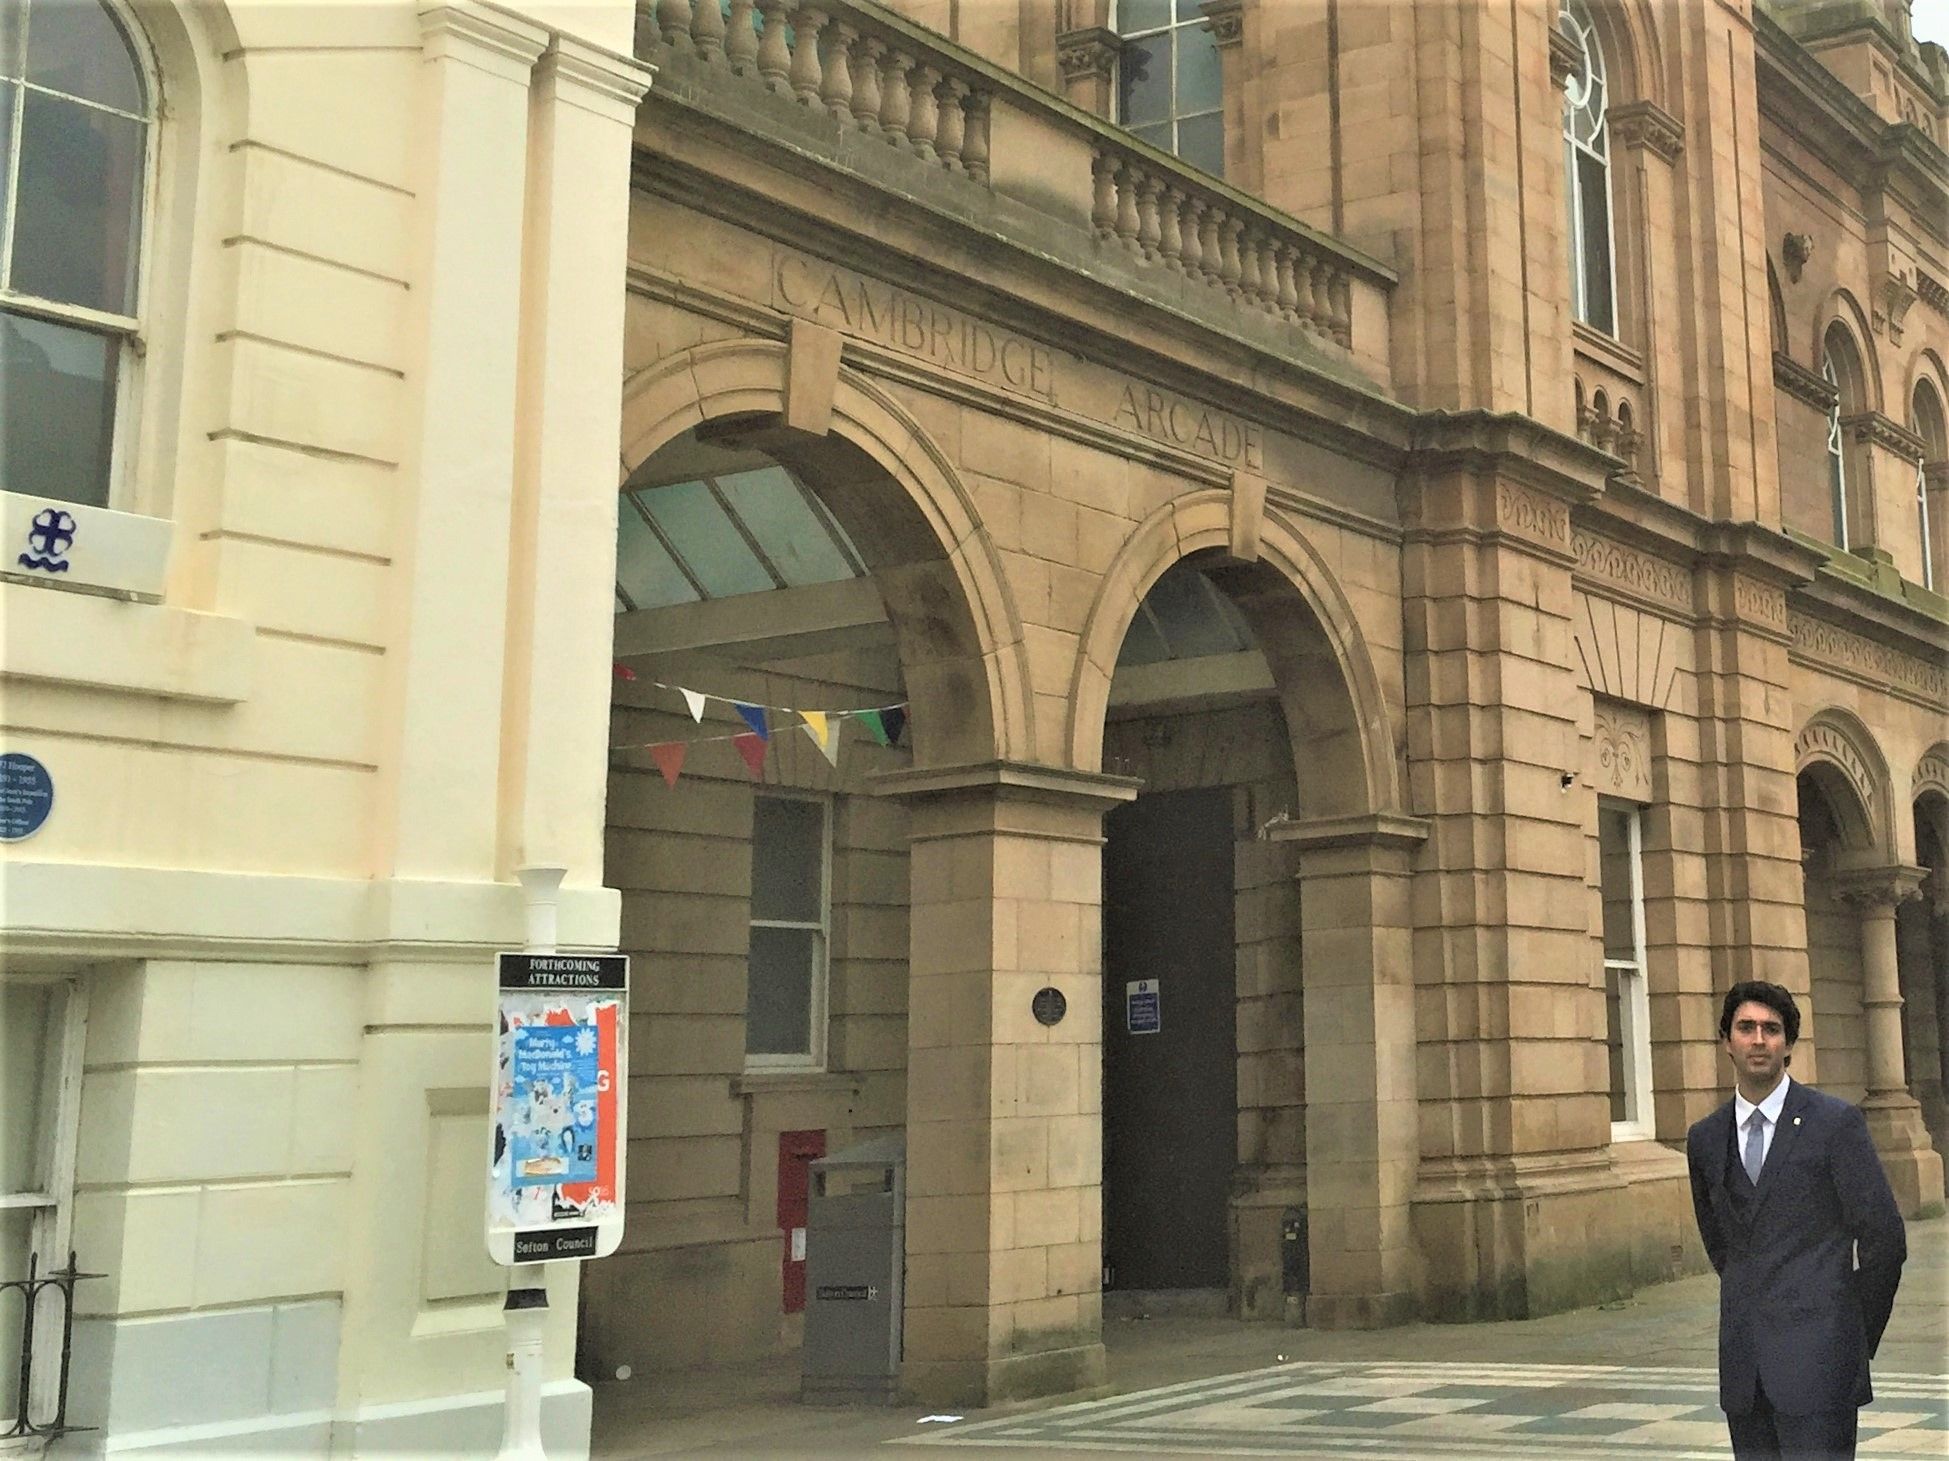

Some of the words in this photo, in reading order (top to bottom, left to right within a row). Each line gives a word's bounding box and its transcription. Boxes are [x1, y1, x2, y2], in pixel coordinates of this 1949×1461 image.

[777, 255, 1054, 397] CAMBRIDGE
[1112, 383, 1260, 470] ARCADE
[529, 958, 600, 972] FORTHCOMING
[528, 972, 600, 986] ATTRACTIONS
[516, 1241, 549, 1254] Sefton
[555, 1236, 593, 1251] Council
